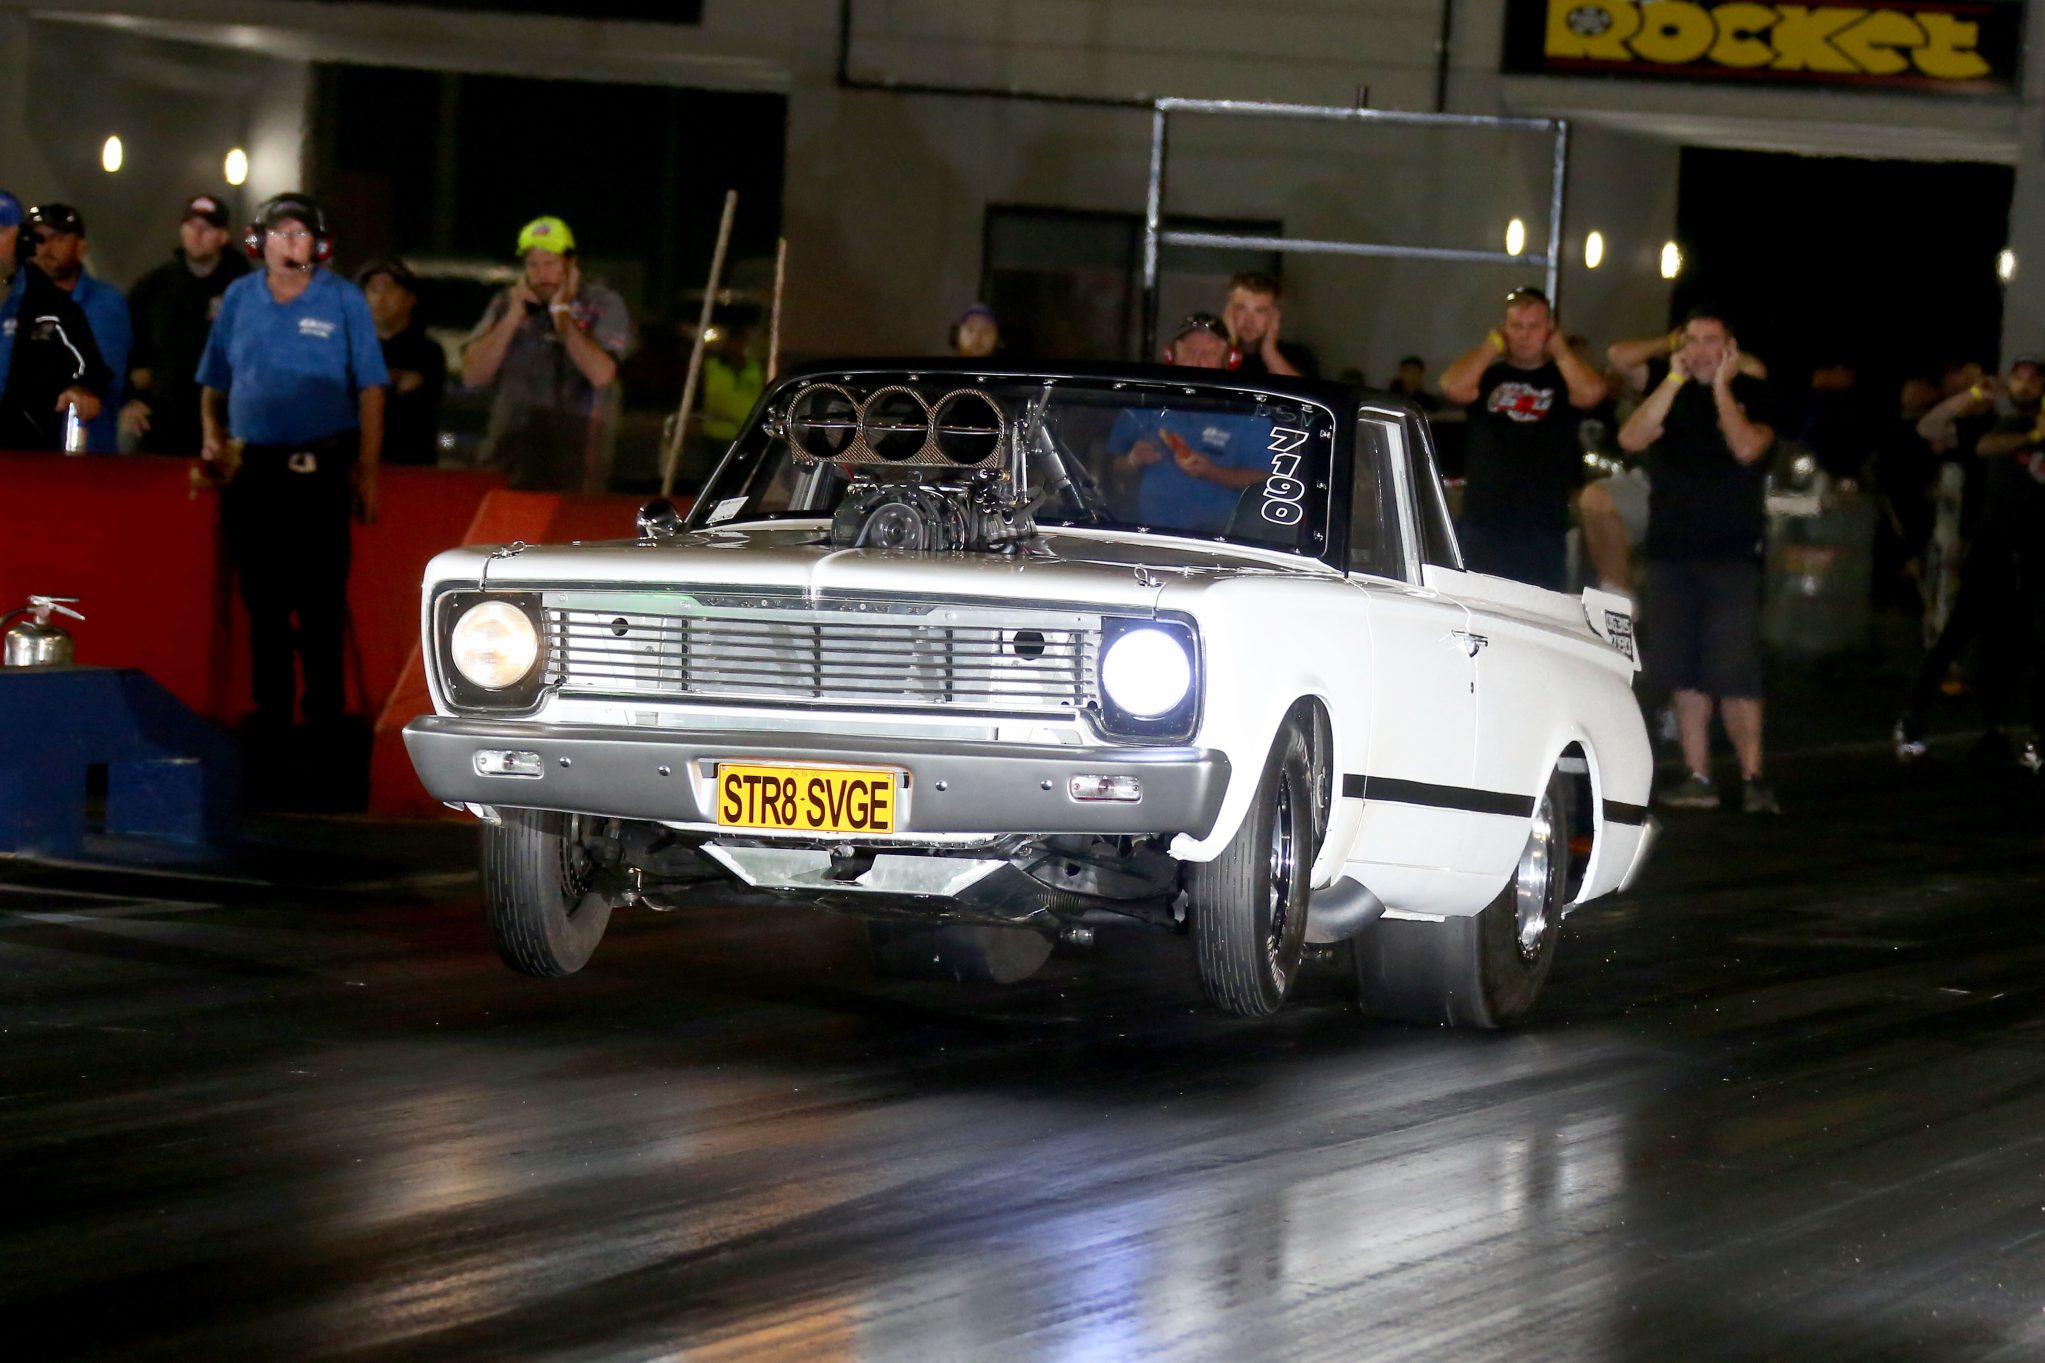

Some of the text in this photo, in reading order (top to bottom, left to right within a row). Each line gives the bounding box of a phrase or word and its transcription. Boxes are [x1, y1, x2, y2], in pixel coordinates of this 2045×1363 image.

[1261, 427, 1309, 525] 7190
[724, 774, 889, 829] STR8 SVGE
